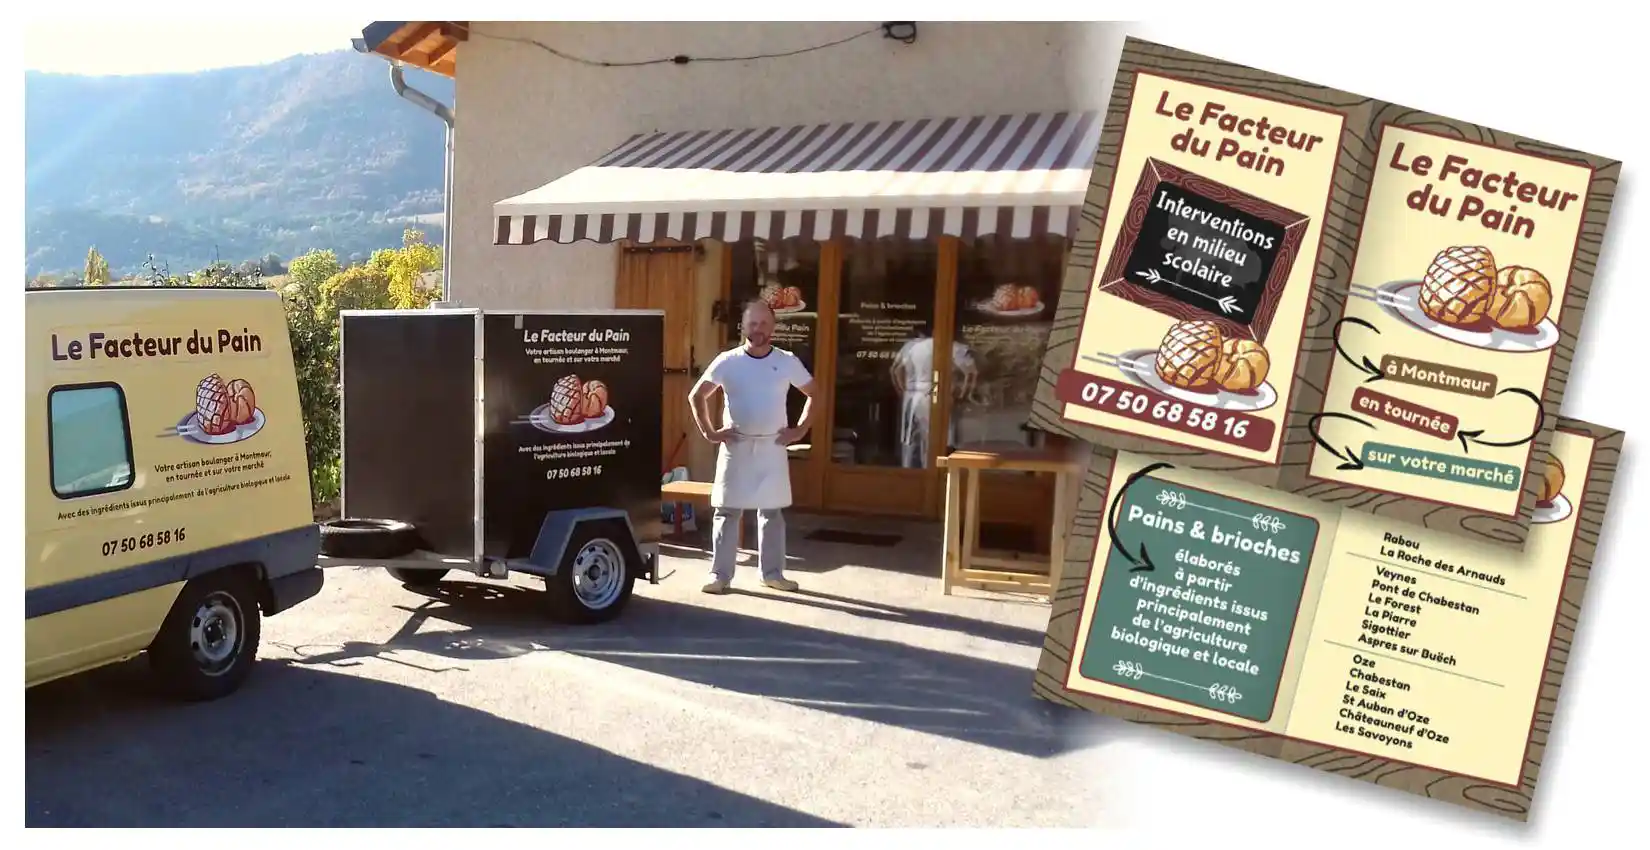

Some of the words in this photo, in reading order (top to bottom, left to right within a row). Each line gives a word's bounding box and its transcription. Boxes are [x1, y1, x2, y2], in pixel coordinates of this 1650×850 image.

[1155, 90, 1194, 121] Le
[1199, 101, 1323, 152] Facteur
[1170, 127, 1211, 157] du
[1215, 138, 1285, 176] Pain
[1389, 142, 1433, 177] Le
[1438, 154, 1579, 211] Facteur
[1156, 190, 1275, 250] Interventions
[1406, 184, 1452, 217] du
[1456, 194, 1535, 238] Pain
[1167, 227, 1189, 244] en
[1192, 232, 1247, 267] milieu
[1162, 252, 1233, 287] scolaire
[51, 334, 83, 361] Le
[89, 332, 182, 358] Facteur
[186, 329, 213, 355] du
[217, 328, 261, 353] Pain
[523, 329, 539, 343] Le
[540, 329, 587, 342] Facteur
[588, 328, 603, 342] du
[605, 328, 630, 342] Pain
[542, 355, 566, 363] tournée
[600, 354, 621, 362] marché
[564, 347, 594, 355] boulanger
[856, 350, 867, 358] 07
[1386, 360, 1397, 376] à
[1401, 362, 1491, 393] Montmaur
[1081, 382, 1115, 403] 07
[1116, 389, 1148, 414] 50
[1152, 400, 1184, 423] 68
[1186, 406, 1218, 431] 58
[1223, 417, 1250, 438] 16
[1359, 396, 1380, 412] en
[1384, 401, 1451, 434] tournée
[542, 443, 572, 452] ingrédients
[586, 440, 623, 449] principalement
[567, 450, 594, 458] biologique
[154, 464, 175, 473] Votre
[175, 460, 200, 470] artisan
[201, 456, 234, 467] boulanger
[234, 453, 239, 462] à
[240, 451, 272, 461] Montmaur,
[165, 475, 175, 483] en
[176, 471, 203, 481] tournée
[204, 469, 211, 477] et
[224, 465, 241, 474] votre
[242, 460, 264, 470] marché
[547, 469, 558, 480] 07
[558, 468, 569, 478] 50
[570, 467, 581, 477] 68
[582, 466, 592, 476] 58
[593, 465, 602, 475] 16
[1367, 450, 1396, 465] sur
[1399, 453, 1446, 473] votre
[1451, 462, 1514, 485] marché
[57, 512, 76, 520] Avec
[77, 508, 90, 517] des
[90, 501, 130, 516] ingrédients
[130, 499, 147, 508] issus
[148, 490, 195, 507] principalement
[196, 489, 205, 497] de
[240, 478, 268, 489] biologique
[274, 473, 291, 483] locale
[102, 540, 118, 556] 07
[121, 537, 136, 553] 50
[139, 533, 154, 549] 68
[157, 530, 171, 546] 58
[174, 527, 186, 542] 16
[1128, 504, 1185, 535] Pains
[1189, 520, 1205, 540] &
[1211, 525, 1301, 565] brioches
[1383, 532, 1420, 550] Rabou
[1174, 549, 1241, 577] élaborés
[1376, 565, 1417, 585] Veynes
[1379, 545, 1395, 558] La
[1397, 550, 1432, 568] Roche
[1434, 559, 1454, 573] des
[1456, 565, 1506, 586] Arnauds
[1174, 567, 1184, 581] à
[1186, 573, 1233, 593] partir
[1368, 592, 1383, 605] Le
[1384, 596, 1422, 615] Forest
[1371, 576, 1400, 595] Pont
[1401, 587, 1416, 599] de
[1418, 591, 1480, 616] Chabestan
[1132, 614, 1150, 629] de
[1136, 598, 1252, 636] principalement
[1230, 600, 1269, 621] issus
[1364, 606, 1380, 618] La
[1381, 610, 1417, 628] Piarre
[1361, 619, 1412, 640] Sigottier
[1111, 625, 1190, 658] biologique
[1193, 648, 1211, 663] et
[1212, 654, 1260, 676] locale
[1352, 654, 1376, 669] Oze
[1358, 633, 1398, 652] Aspres
[1400, 645, 1419, 657] sur
[1421, 648, 1457, 667] Buëch
[1345, 681, 1360, 693] Le
[1361, 685, 1387, 700] Saix
[1349, 668, 1411, 692] Chabestan
[1342, 694, 1355, 707] St
[1357, 698, 1394, 716] Auban
[1335, 721, 1355, 735] Les
[1357, 726, 1413, 750] Savoyons
